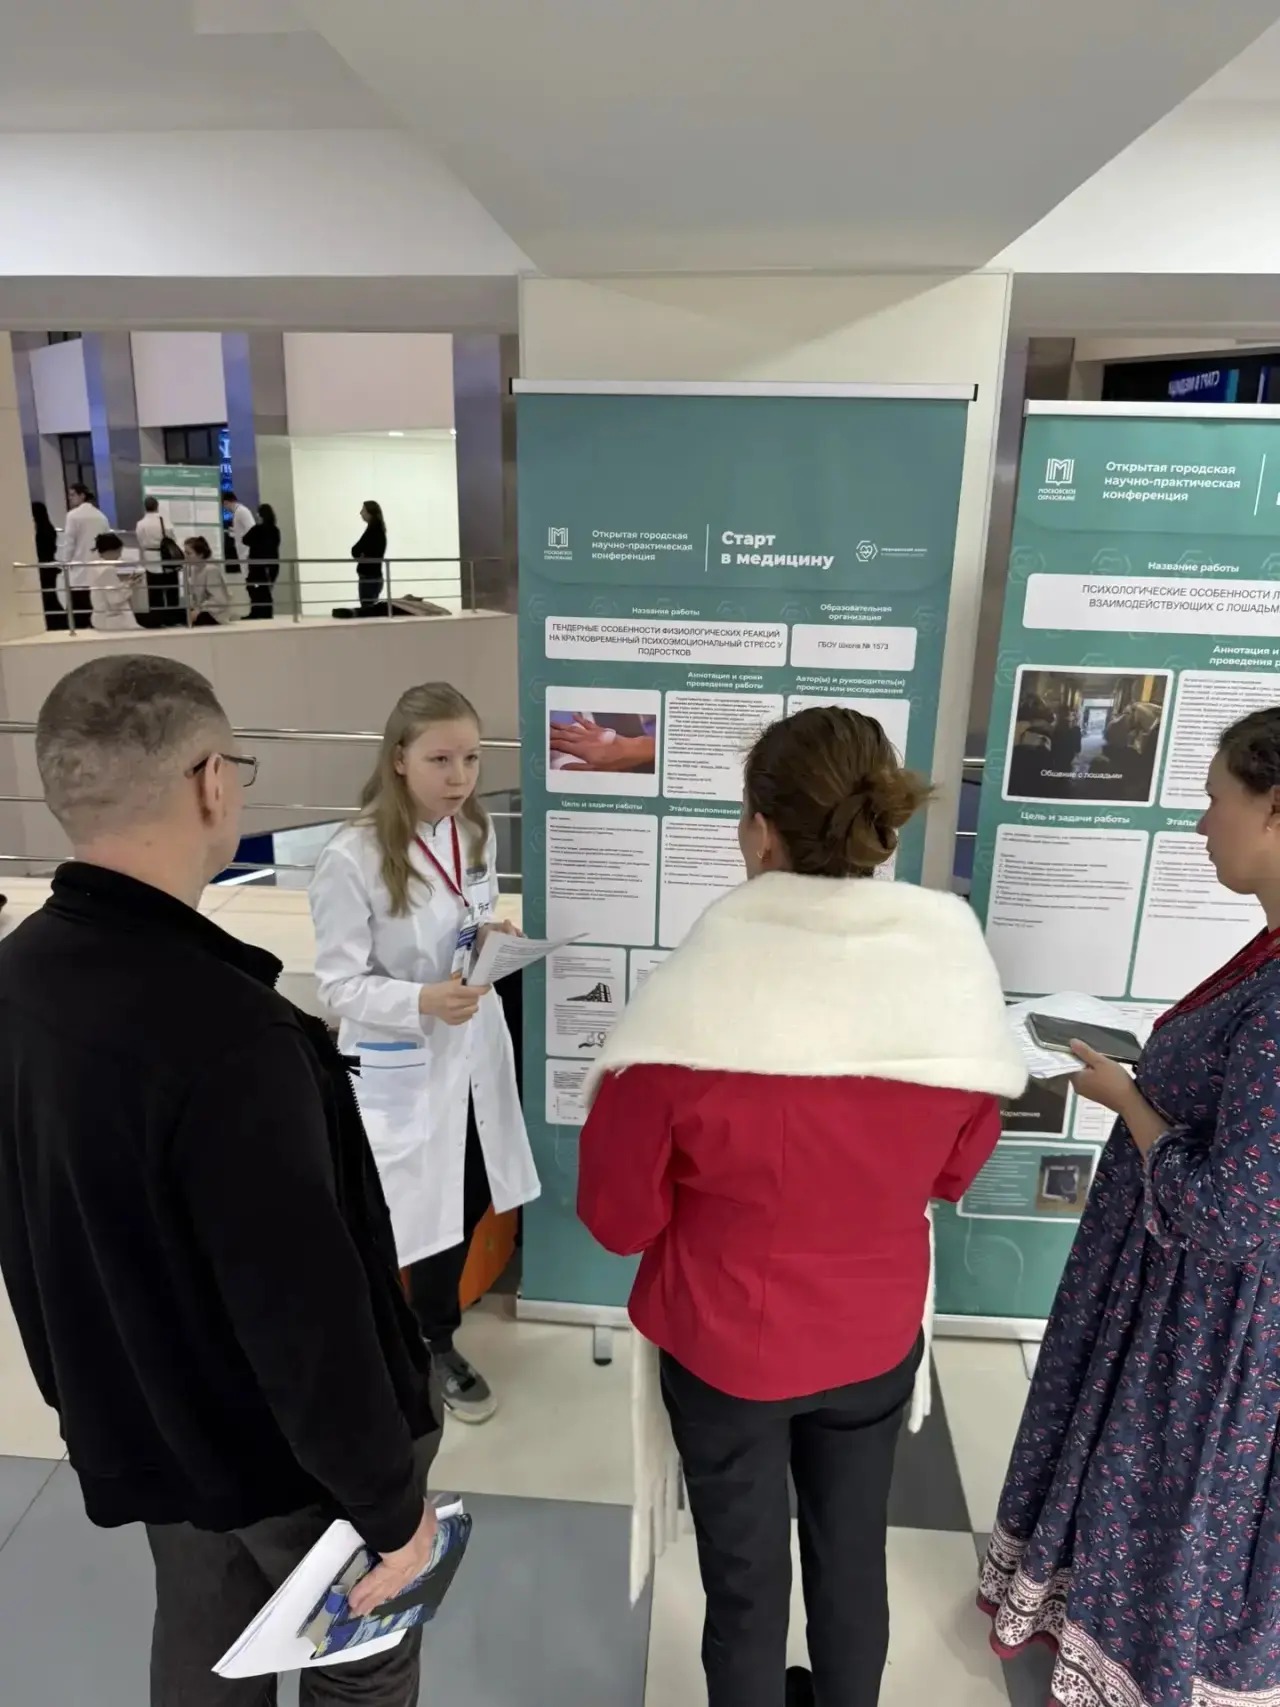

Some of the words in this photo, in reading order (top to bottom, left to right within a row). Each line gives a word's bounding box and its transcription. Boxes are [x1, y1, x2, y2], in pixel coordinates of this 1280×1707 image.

[1105, 461, 1167, 474] Открытая
[1170, 464, 1236, 476] городская
[1104, 476, 1241, 489] научно-практическая
[1102, 490, 1189, 502] конференция
[591, 530, 638, 540] Открытая
[639, 531, 688, 541] городская
[721, 530, 776, 549] Старт
[591, 541, 693, 552] научно-практическая
[591, 551, 656, 562] конференция
[721, 553, 732, 564] в
[736, 553, 835, 570] медицину
[1147, 562, 1198, 572] Название
[1200, 563, 1240, 574] работы
[1082, 584, 1187, 597] ПСИХОЛОГИЧЕСКИЕ
[1189, 587, 1271, 600] ОСОБЕННОСТИ
[632, 607, 669, 616] Название
[671, 608, 700, 617] работы
[820, 603, 893, 613] Образовательная
[1089, 598, 1213, 612] ВЗАИМОДЕЙСТВУЮЩИХ
[1216, 602, 1224, 611] С
[1226, 603, 1280, 615] ЛОШАДЬМ
[828, 613, 882, 621] организация
[552, 623, 600, 632] ГЕНДЕРНЫЕ
[600, 625, 661, 634] ОСОБЕННОСТИ
[662, 627, 741, 637] ФИЗИОЛОГИЧЕСКИХ
[742, 629, 781, 638] РЕАКЦИЙ
[561, 634, 640, 644] КРАТКОВРЕМЕННЫЙ
[641, 637, 742, 647] ПСИХОЭМОЦИОНАЛЬНЫЙ
[743, 641, 776, 649] СТРЕСС
[638, 647, 692, 656] ПОДРОСТКОВ
[1212, 645, 1270, 656] Аннотация
[1209, 656, 1273, 667] проведения
[615, 802, 643, 810] работы
[1020, 811, 1047, 821] Цель
[1057, 814, 1093, 823] задачи
[1094, 814, 1130, 824] работы
